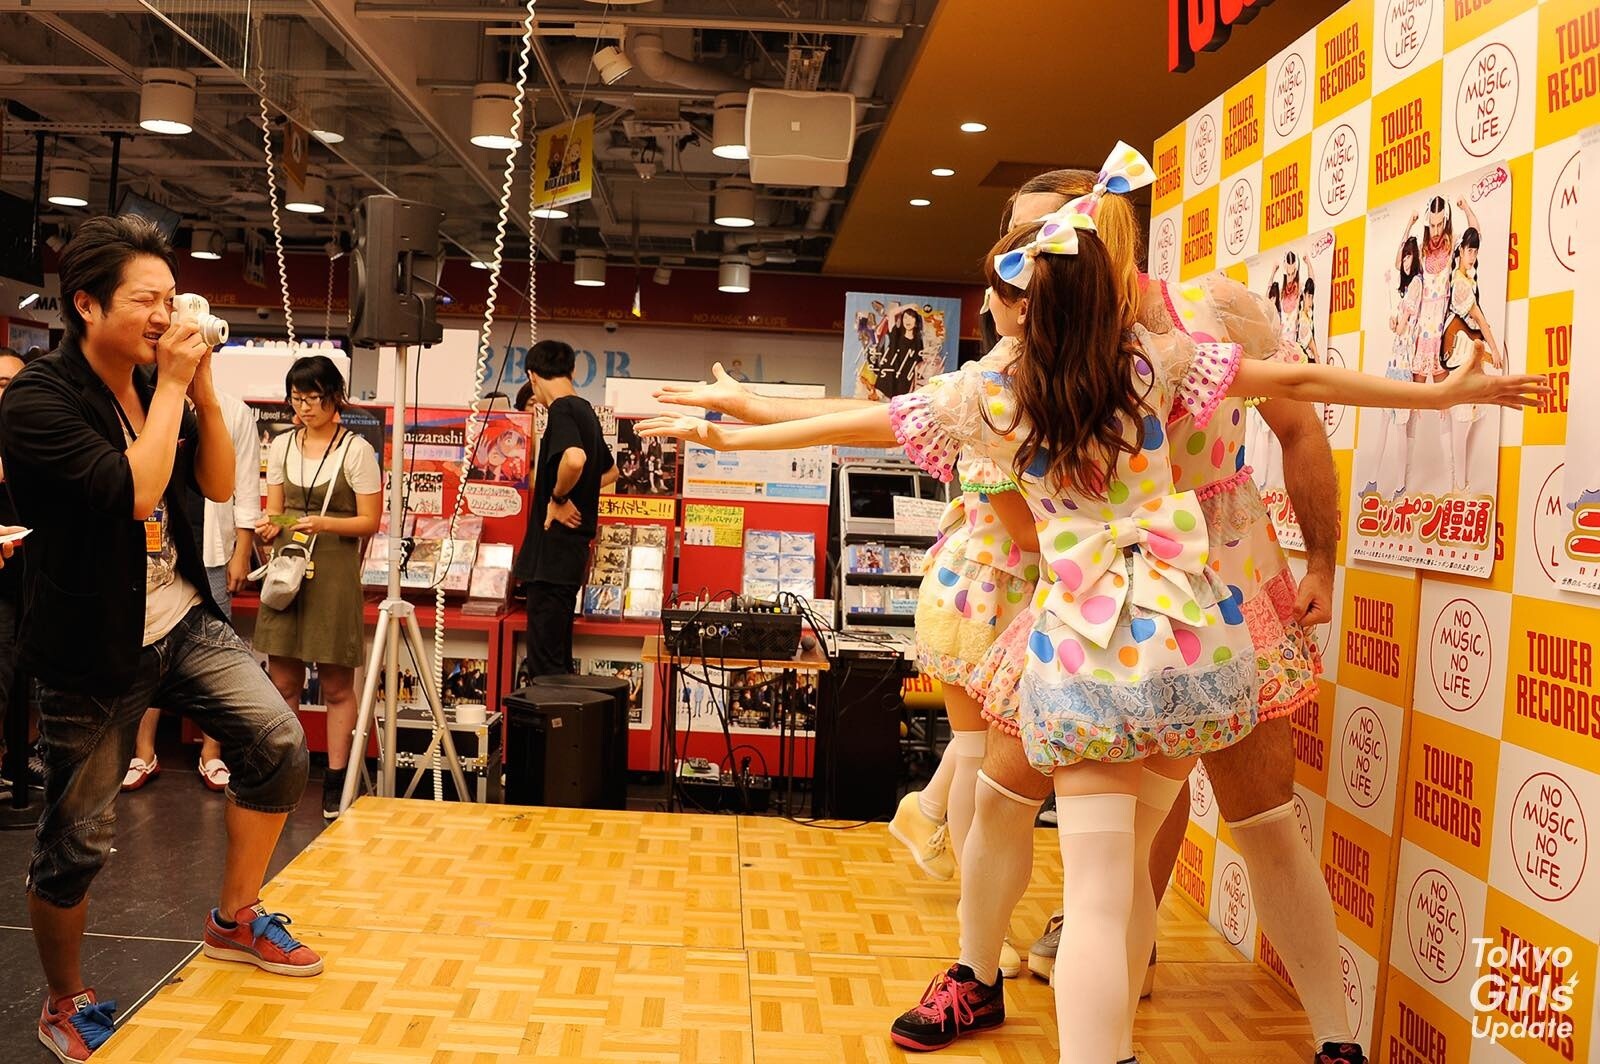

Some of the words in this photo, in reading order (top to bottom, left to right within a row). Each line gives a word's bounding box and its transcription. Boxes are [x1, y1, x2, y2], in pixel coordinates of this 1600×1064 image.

[1400, 15, 1414, 36] NO
[1556, 8, 1600, 64] TOW
[1324, 22, 1358, 69] TOWER
[1396, 31, 1419, 57] LIFE.
[1285, 61, 1295, 77] NO
[1320, 50, 1365, 104] RECORDS
[1478, 54, 1496, 76] NO
[1465, 67, 1511, 104] MUSIC,
[1548, 52, 1600, 113] RECO
[1228, 95, 1253, 131] TOWER
[1284, 93, 1294, 109] NO
[1477, 97, 1495, 120] NO
[1381, 98, 1422, 146] TOWER
[1471, 116, 1501, 144] LIFE.
[1225, 118, 1258, 160] RECORDS
[1333, 133, 1345, 150] NO
[1159, 145, 1177, 174] TOWER
[1324, 145, 1354, 171] MUSIC,
[1376, 131, 1430, 185] RECORDS
[1156, 167, 1180, 200] RECORDS
[1270, 162, 1298, 200] TOWER
[1327, 178, 1348, 204] LIFE.
[1332, 168, 1344, 184] NO
[1235, 186, 1244, 200] NO
[1188, 208, 1210, 238] TOWER
[1234, 216, 1242, 229] NO
[1266, 191, 1303, 232] RECORDS
[1184, 232, 1212, 265] RECORDS
[1360, 498, 1490, 543] ニッポン饅頭
[1354, 596, 1394, 638] TOWER
[1454, 610, 1471, 628] NO
[1347, 631, 1400, 678] RECORDS
[1440, 628, 1485, 657] MUSIC,
[1450, 654, 1468, 672] NO
[1526, 631, 1592, 687] TOWER
[1443, 672, 1472, 699] LIFE.
[1517, 674, 1600, 740] RECORDS
[1360, 716, 1373, 734] NO
[1349, 731, 1382, 761] MUSIC,
[1356, 755, 1370, 773] NO
[1423, 744, 1473, 800] TOWER
[1350, 770, 1372, 798] LIFE.
[1541, 784, 1562, 808] NO
[1414, 781, 1481, 848] RECORDS
[1523, 801, 1578, 845] MUSIC,
[1332, 830, 1370, 887] TOWER
[1536, 833, 1557, 857] NO
[1176, 859, 1205, 907] RECORDS
[1232, 870, 1241, 886] NO
[1526, 851, 1562, 890] LIFE.
[1431, 880, 1447, 901] NO
[1229, 902, 1238, 917] NO
[1417, 893, 1459, 936] MUSIC,
[1426, 922, 1443, 944] NO
[1420, 938, 1446, 974] LIFE.
[1399, 1001, 1446, 1064] TOWER
